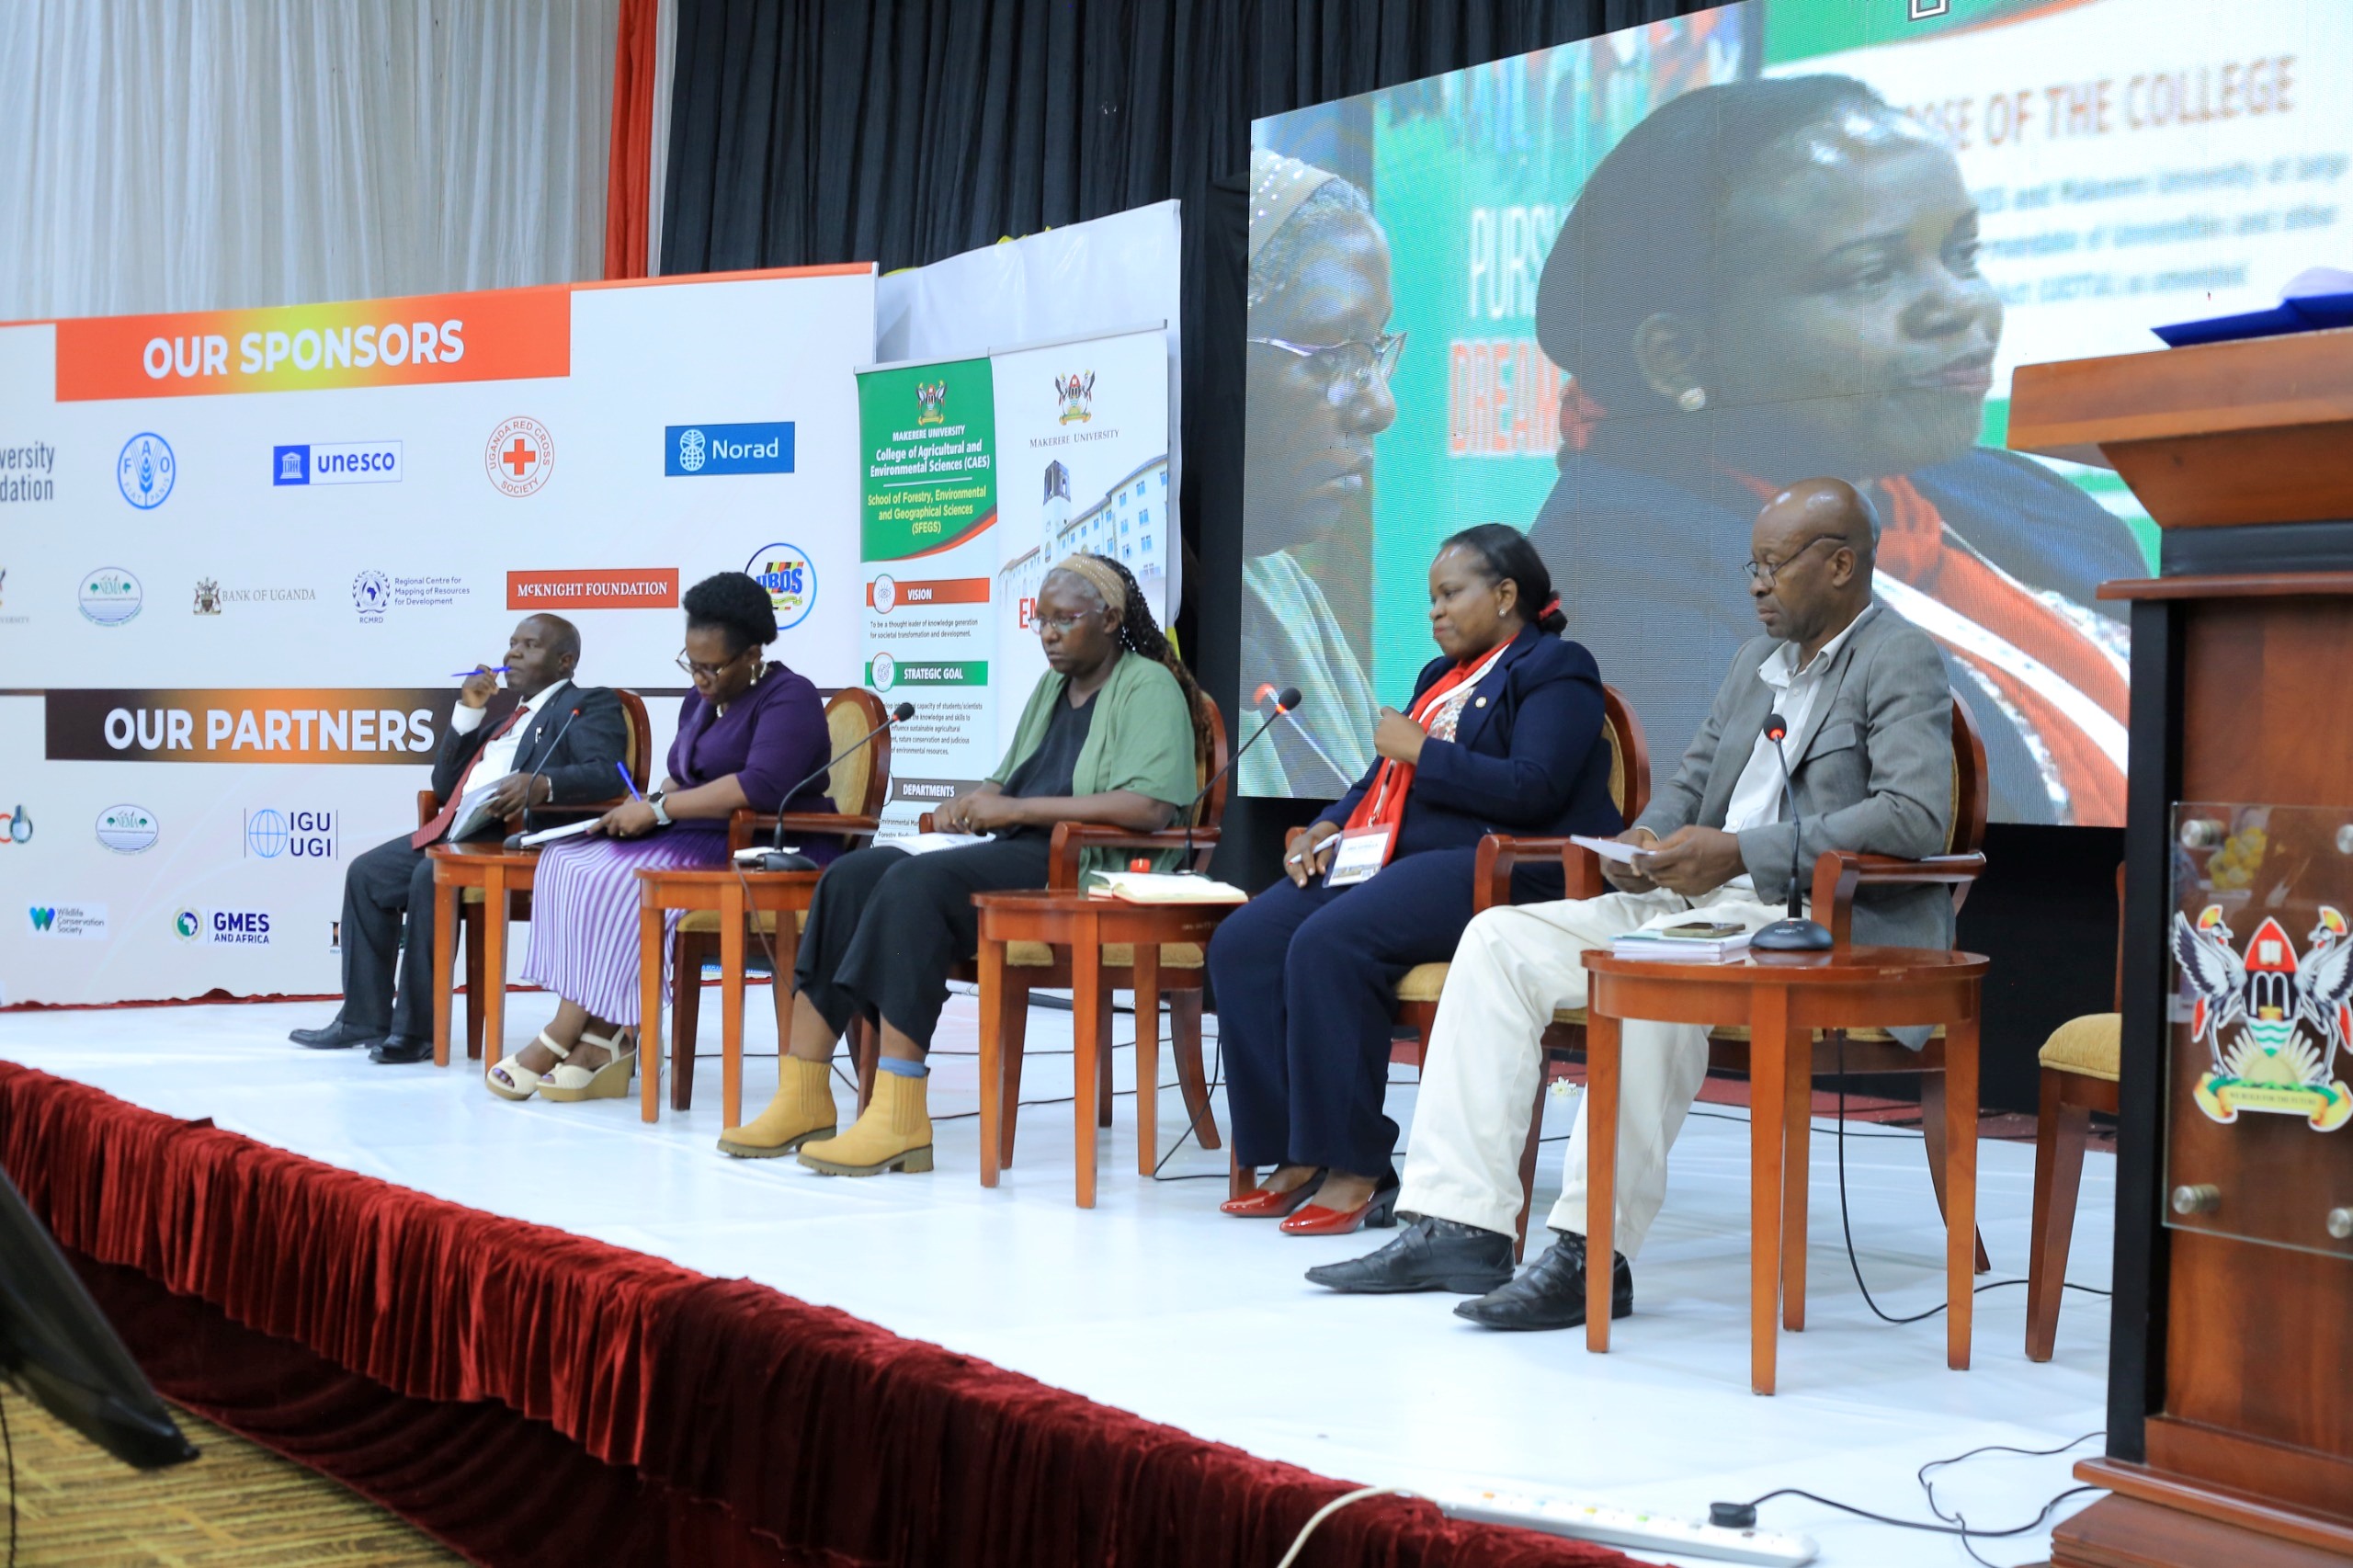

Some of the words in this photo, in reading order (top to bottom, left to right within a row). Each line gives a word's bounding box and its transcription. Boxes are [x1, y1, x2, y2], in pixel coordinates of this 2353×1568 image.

[1986, 90, 2032, 147] OF
[2044, 78, 2113, 139] THE
[2126, 54, 2296, 131] COLLEGE
[143, 335, 228, 380] OUR
[239, 319, 465, 375] SPONSORS
[892, 429, 926, 441] MAKERERE
[928, 425, 965, 438] UNIVERSITY
[1029, 435, 1070, 449] MAKERERE
[1074, 428, 1120, 443] UNIVERSITY
[489, 425, 511, 470] UGANDA
[513, 421, 533, 431] RED
[534, 427, 551, 466] CROSS
[712, 437, 779, 460] Norad
[876, 448, 906, 462] College
[908, 445, 917, 459] of
[918, 440, 964, 460] Agricultural
[966, 438, 982, 452] and
[318, 450, 395, 472] unesco
[870, 460, 927, 477] Environmental
[929, 459, 962, 472] Sciences
[964, 454, 990, 471] (CAES)
[501, 477, 539, 494] SOCIETY
[868, 494, 891, 506] School
[892, 492, 901, 504] of
[903, 490, 934, 504] Forestry,
[935, 485, 986, 501] Environmental
[879, 508, 892, 520] and
[894, 505, 941, 521] Geographical
[943, 504, 973, 517] Sciences
[912, 520, 941, 535] (SFEGS)
[99, 581, 122, 595] NEMA
[394, 577, 424, 586] Regional
[451, 576, 461, 585] for
[585, 581, 667, 596] FOUNDATION
[756, 568, 802, 594] UBOS
[222, 590, 250, 601] BANK
[253, 589, 267, 601] OF
[270, 588, 316, 601] UGANDA
[394, 588, 424, 597] Mapping
[426, 587, 433, 596] of
[907, 588, 932, 601] VISION
[394, 598, 404, 607] for
[406, 597, 452, 607] Development
[889, 620, 907, 629] thought
[928, 619, 954, 628] knowledge
[955, 619, 978, 627] generation
[898, 631, 929, 639] transformation
[904, 668, 941, 680] STRATEGIC
[943, 667, 963, 679] GOAL
[917, 702, 935, 710] capacity
[104, 707, 193, 750] OUR
[206, 709, 435, 753] PARTNERS
[935, 725, 961, 733] agricultural
[903, 784, 955, 797] DEPARTMENTS
[116, 817, 139, 828] NEMA
[290, 812, 331, 832] IGU
[290, 837, 332, 858] UGI
[57, 907, 84, 917] Wildlife
[57, 917, 104, 927] Conservation
[214, 912, 269, 932] GMES
[57, 926, 83, 936] Society
[214, 933, 233, 943] AND
[235, 934, 269, 944] AFRICA
